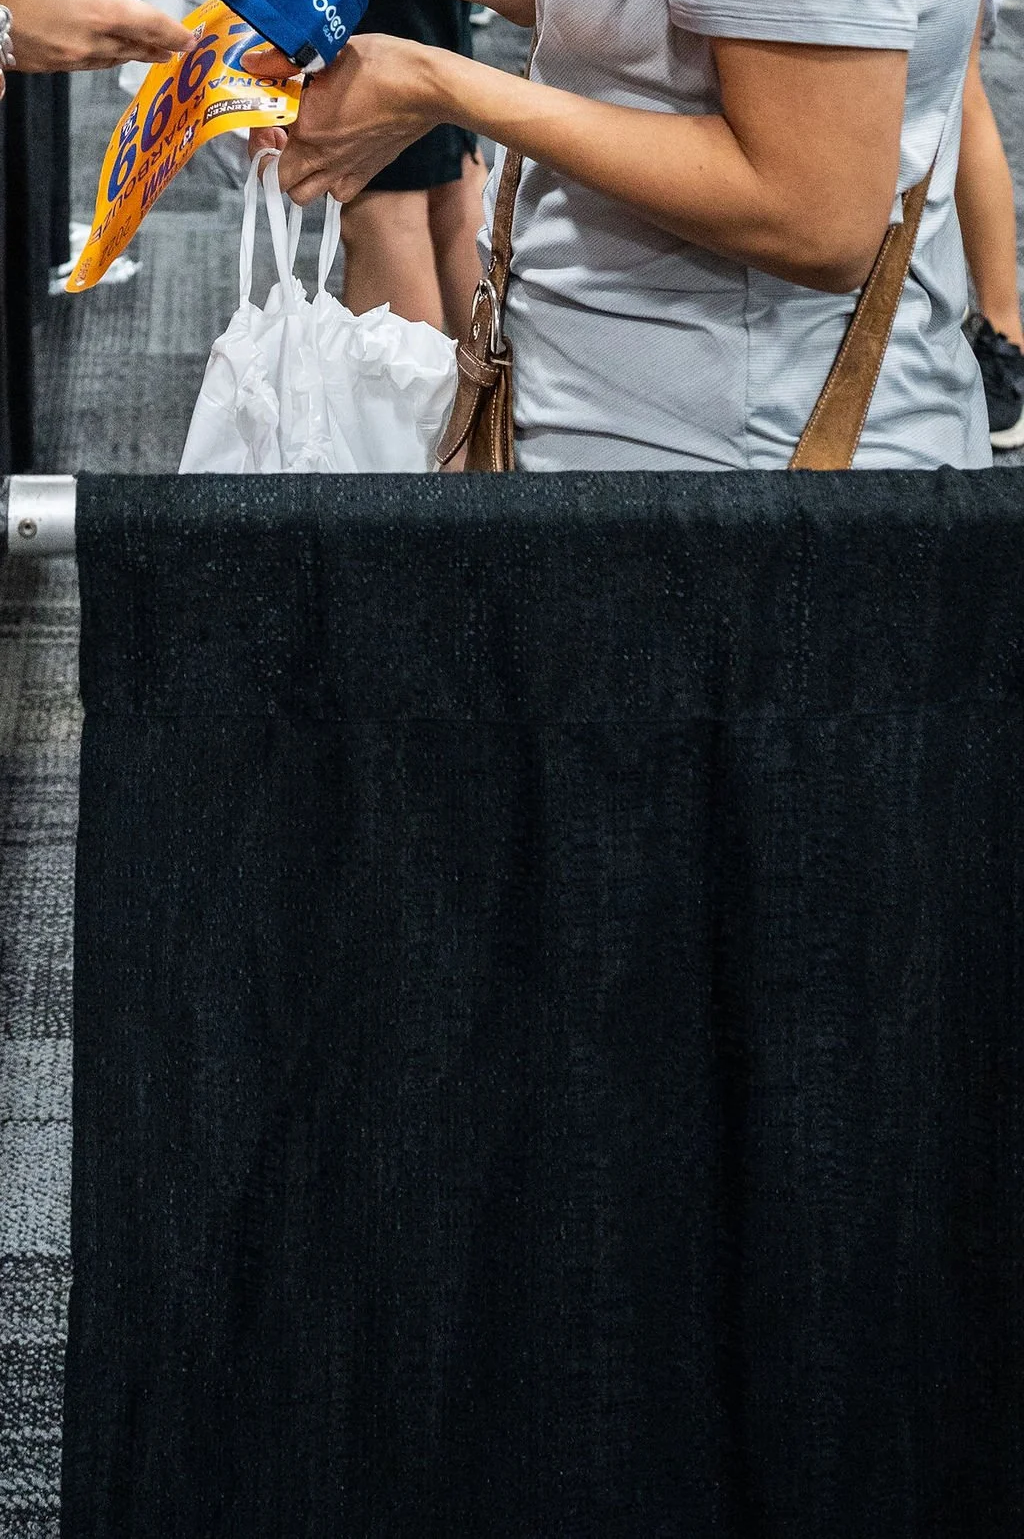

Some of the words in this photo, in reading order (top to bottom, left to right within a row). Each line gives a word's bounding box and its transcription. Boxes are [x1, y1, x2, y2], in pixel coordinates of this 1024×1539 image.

[206, 104, 251, 120] RENKEN
[207, 101, 228, 112] FIRM
[89, 110, 189, 245] DARBOUZE
[98, 215, 132, 267] 2022
